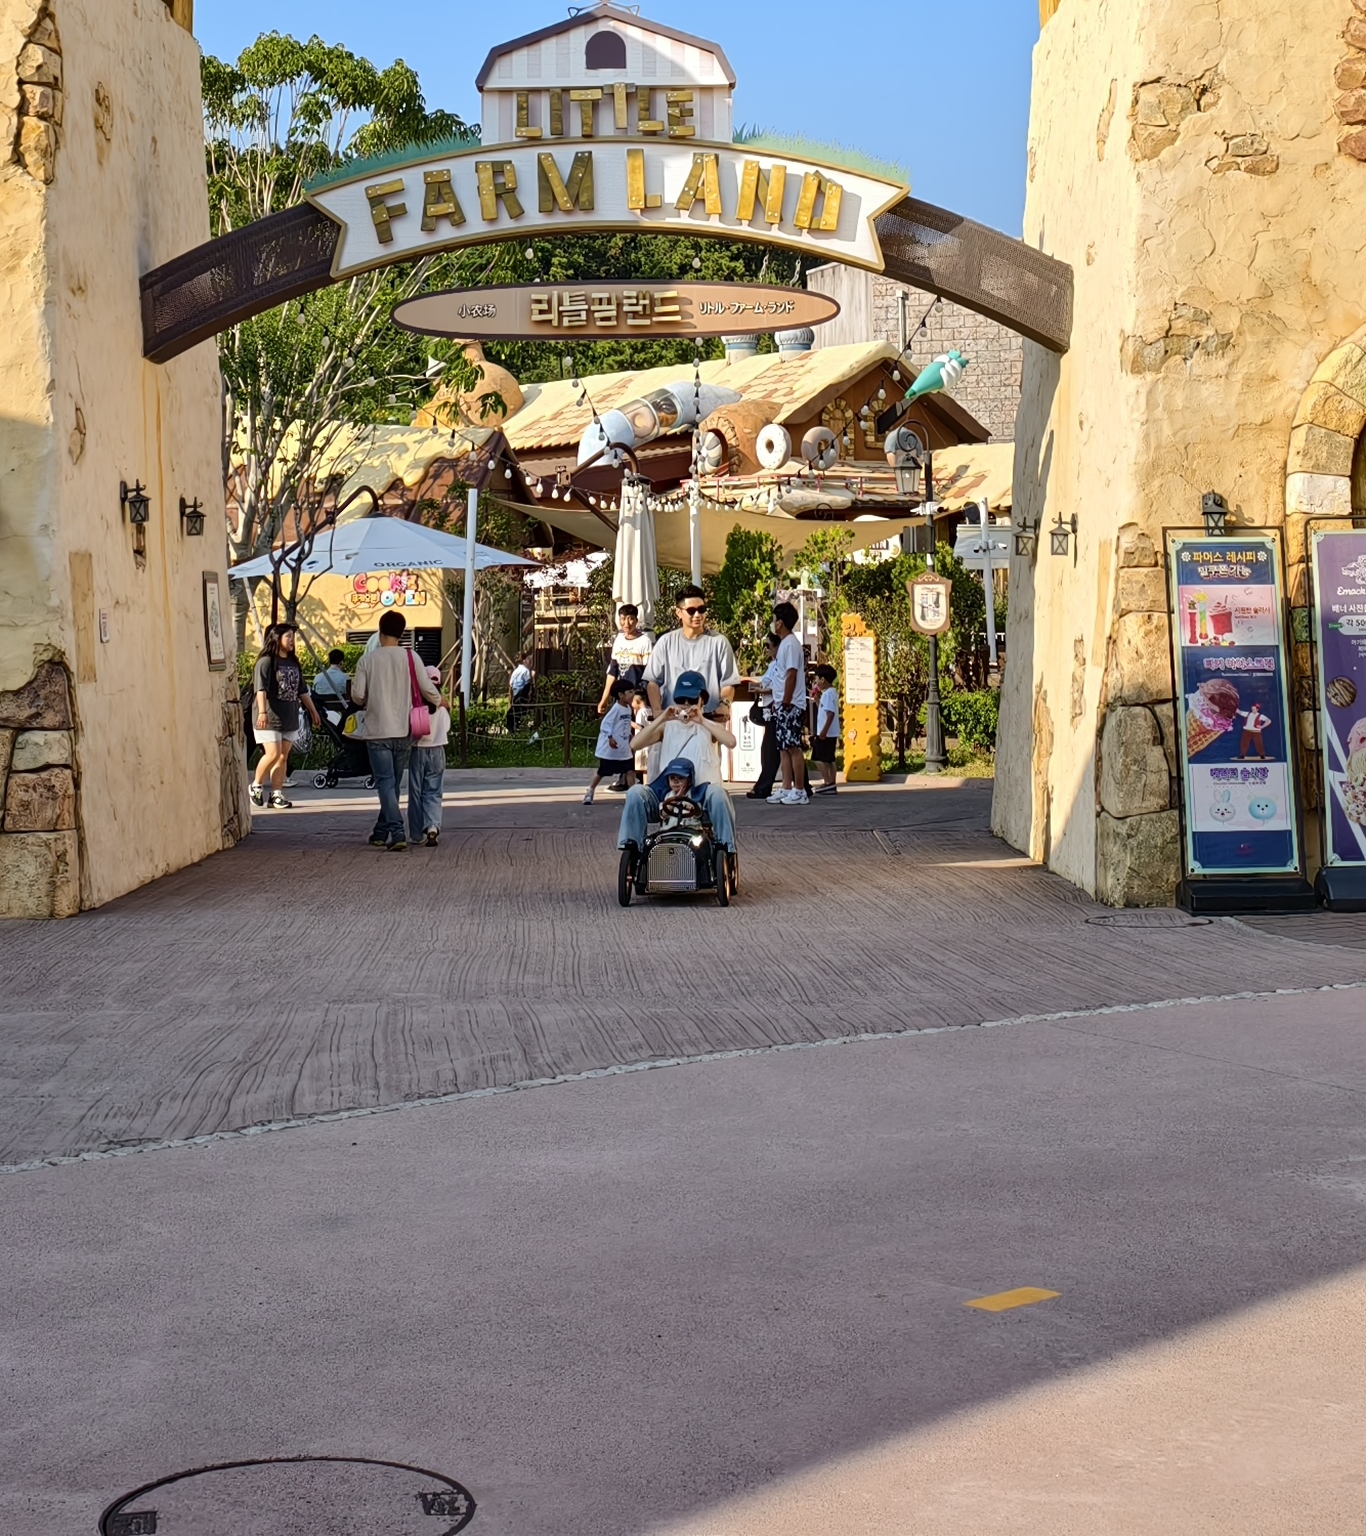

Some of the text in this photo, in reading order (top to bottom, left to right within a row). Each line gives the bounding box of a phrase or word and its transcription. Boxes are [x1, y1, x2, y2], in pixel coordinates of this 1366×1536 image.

[514, 81, 695, 139] LITTLE
[364, 148, 843, 244] FARM LAND
[458, 303, 497, 318] 小农场
[373, 559, 443, 567] ORGANIC
[1192, 550, 1256, 563] 파머스 레시피
[380, 590, 427, 606] OVEN
[1337, 586, 1366, 595] Emack
